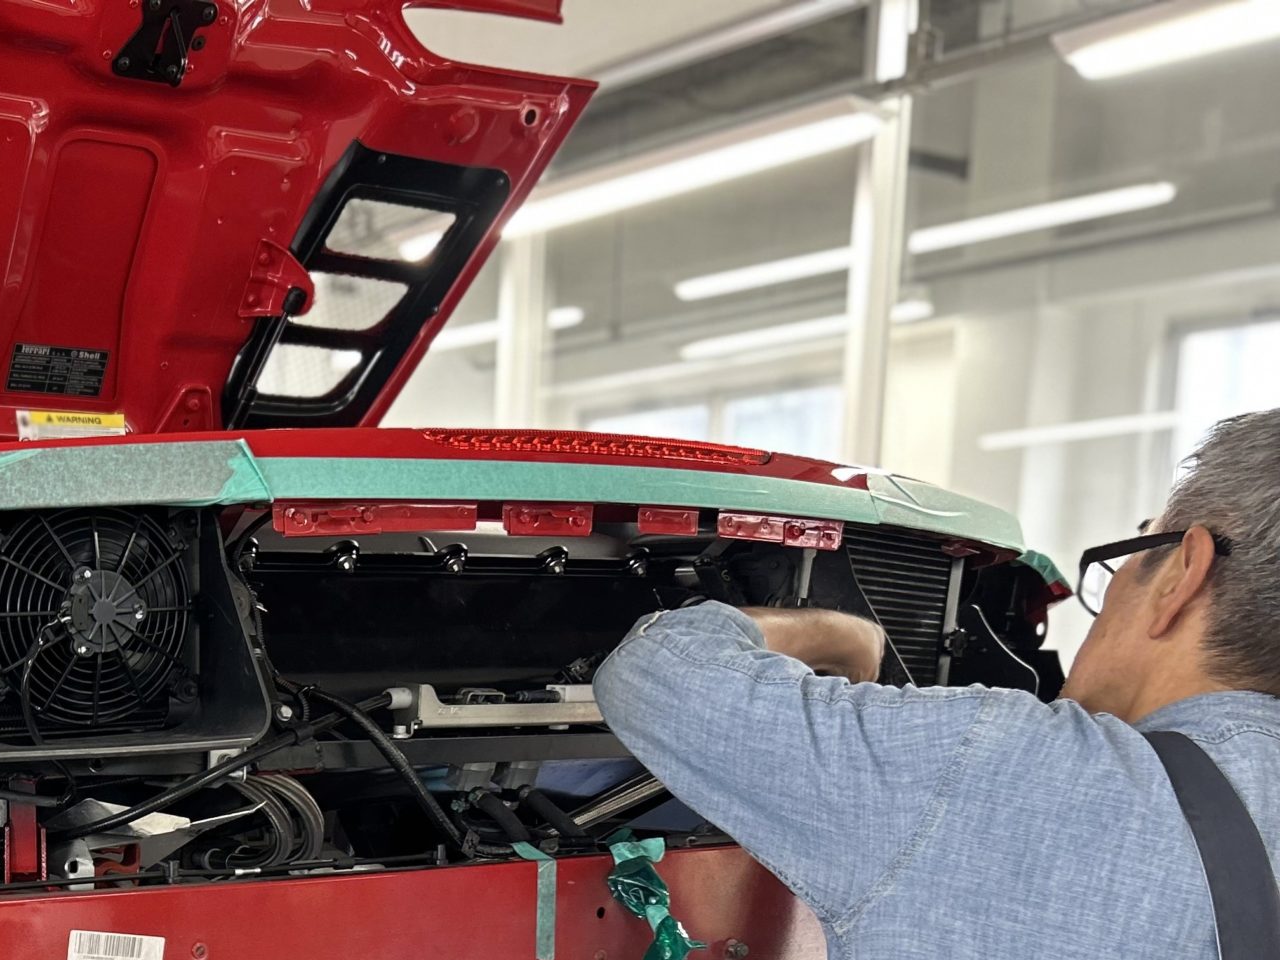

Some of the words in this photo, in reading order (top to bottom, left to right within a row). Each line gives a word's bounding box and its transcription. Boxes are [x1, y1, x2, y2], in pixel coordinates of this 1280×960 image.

[21, 344, 51, 356] Ferrari
[78, 351, 101, 360] Shell
[56, 414, 102, 425] WARNING
